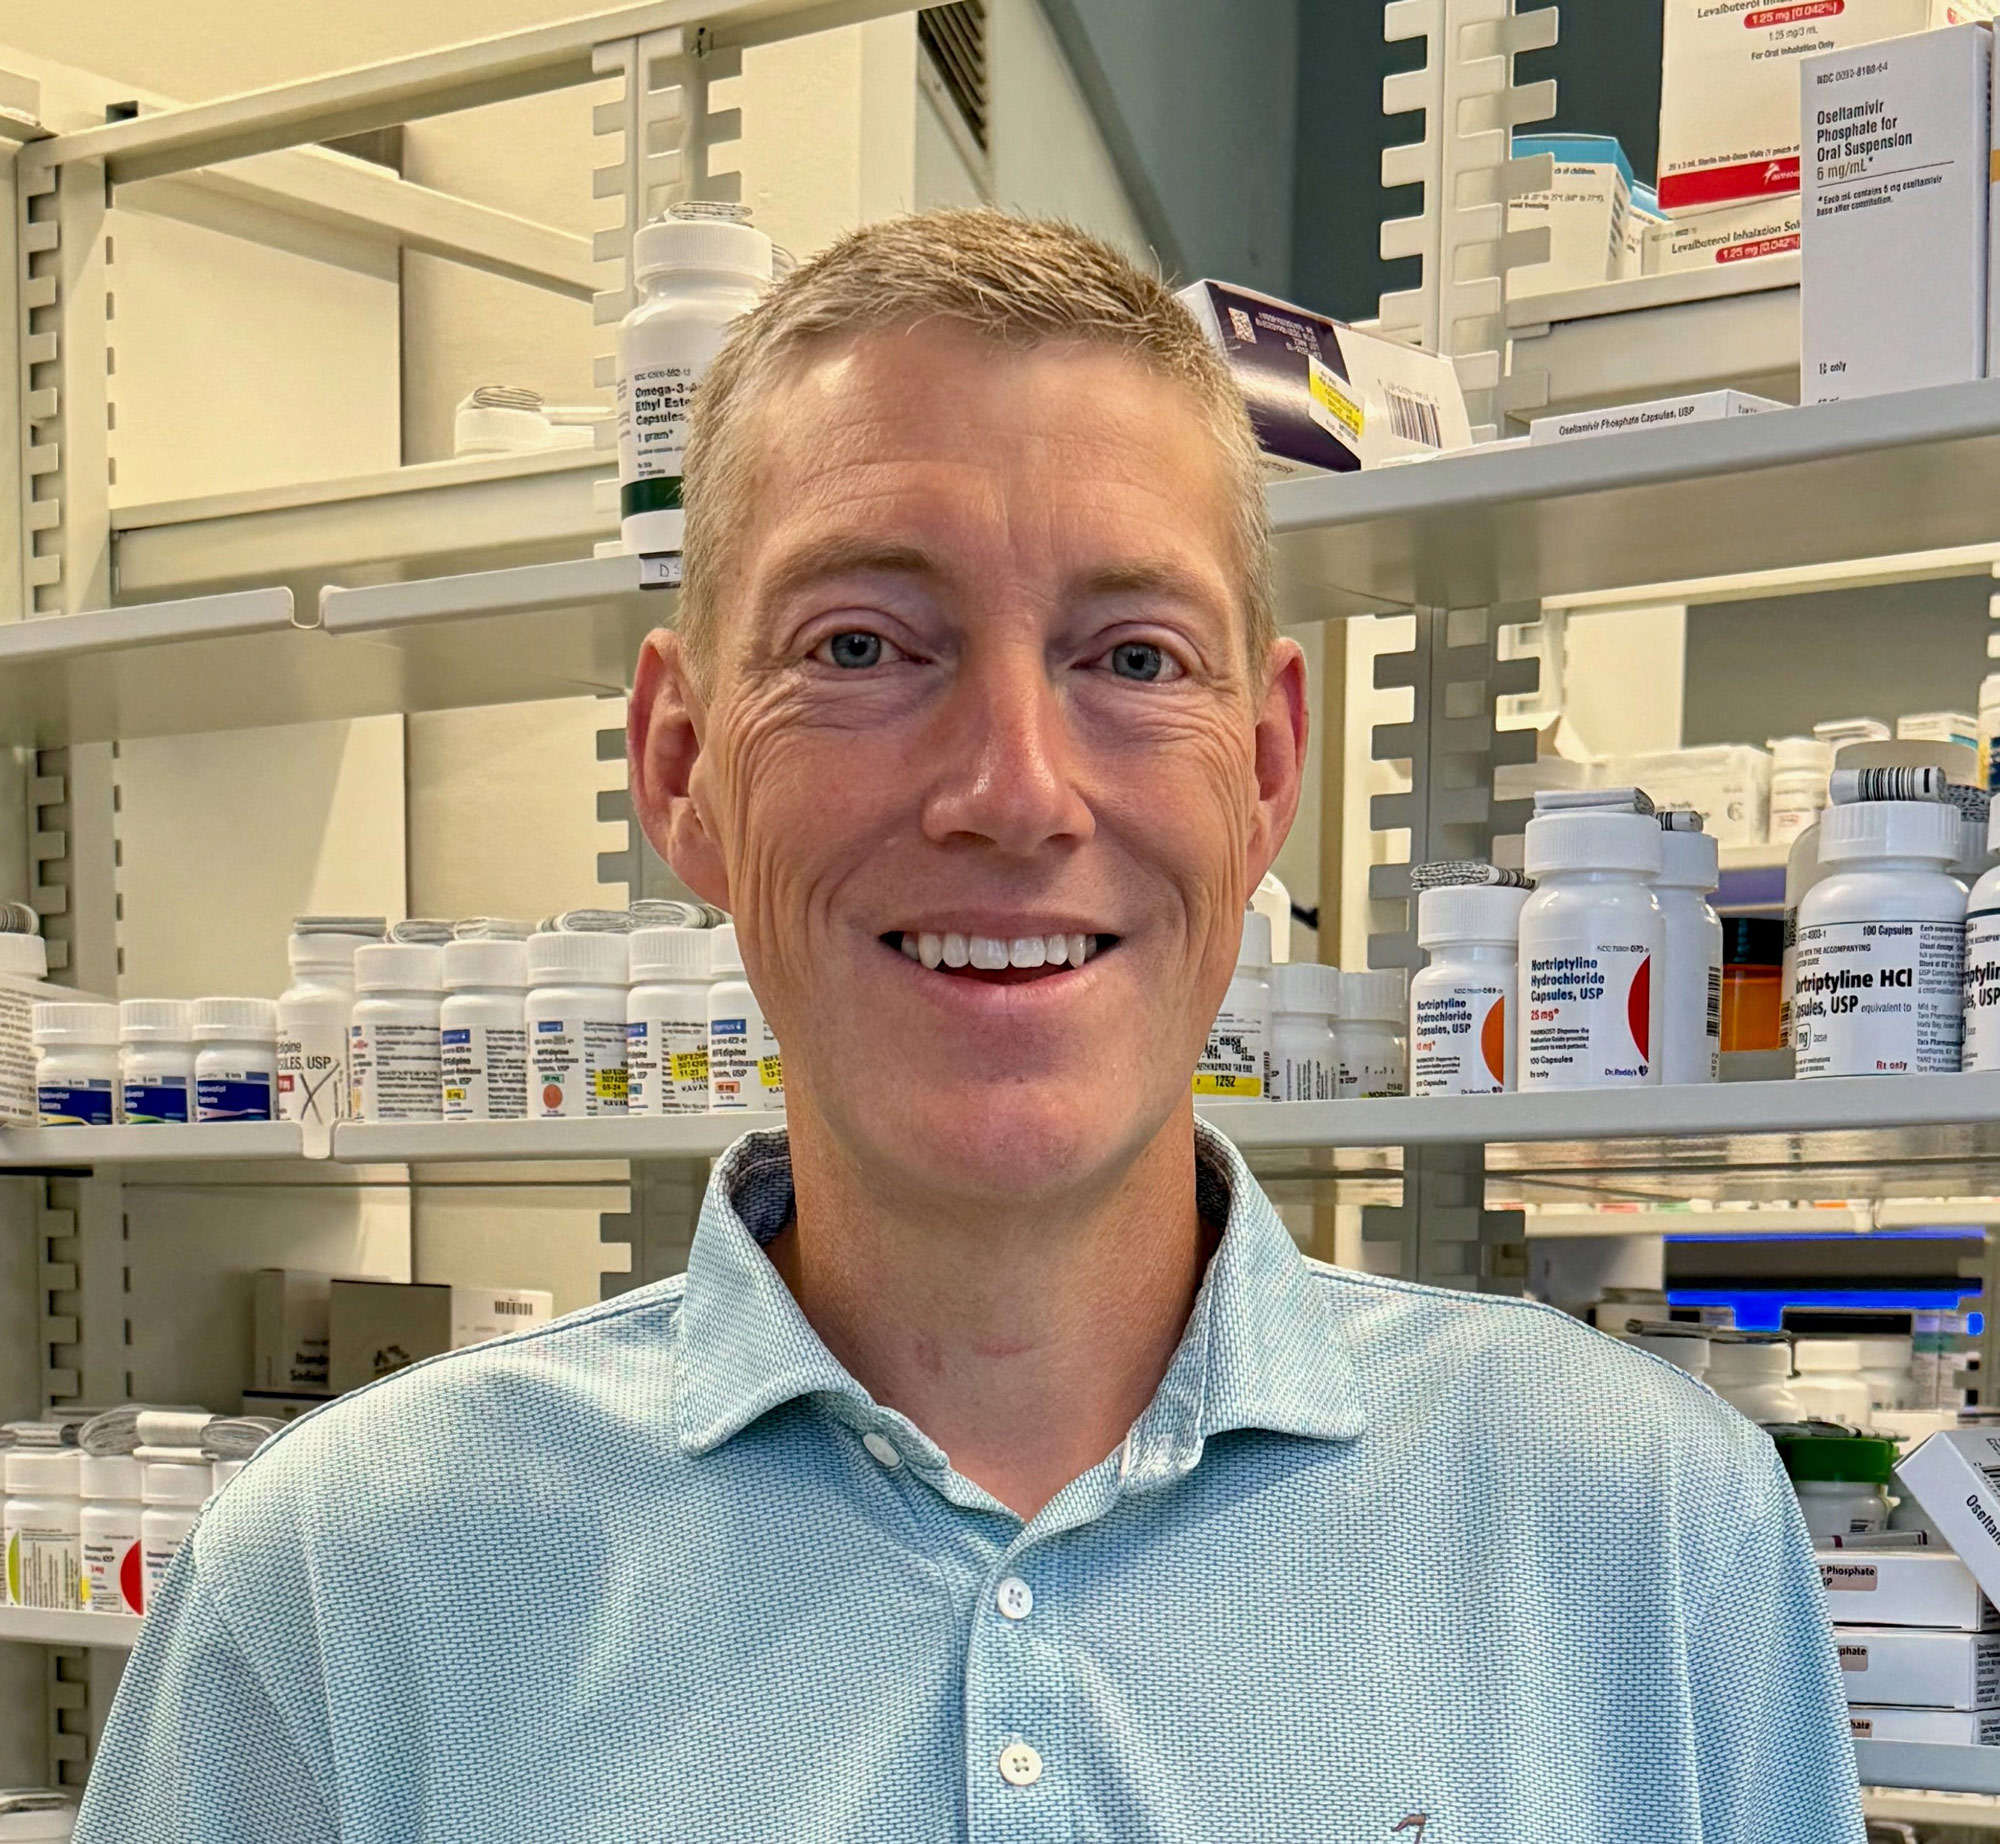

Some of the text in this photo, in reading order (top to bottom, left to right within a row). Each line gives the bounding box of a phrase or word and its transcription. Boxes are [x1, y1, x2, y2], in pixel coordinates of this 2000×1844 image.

[1752, 13, 1773, 25] 1.25
[1775, 11, 1790, 22] mg
[1751, 40, 1835, 61] For Oral Inhalation Only
[1817, 99, 1885, 125] Oseltamivir
[1817, 116, 1898, 144] Phosphate for
[1817, 132, 1913, 162] Oral Suspension
[1817, 166, 1824, 180] 6
[1853, 188, 1882, 199] contains
[1816, 206, 1833, 217] base
[1834, 203, 1850, 214] after
[1671, 232, 1731, 254] Levalbuterol
[1733, 225, 1781, 242] Inhalation
[1722, 247, 1743, 260] 1.25
[1744, 246, 1759, 257] mg
[1830, 361, 1847, 373] only
[635, 399, 660, 412] Ethyl
[1559, 405, 1695, 436] Oseltamivir Phosphate Capsules, USP
[1863, 924, 1913, 937] 100 Capsules
[1920, 924, 1934, 932] Each
[1823, 943, 1871, 955] ACCOMPANYING
[1531, 957, 1598, 971] Nortriptyline
[1531, 972, 1605, 988] Hydrochloride
[1880, 968, 1913, 988] HCl
[1531, 988, 1604, 1004] Capsules, USP
[1417, 998, 1467, 1011] Nortriptyline
[1831, 996, 1858, 1014] USP
[1861, 1002, 1902, 1015] equivalent
[1903, 1001, 1912, 1013] to
[1417, 1011, 1472, 1025] Hydrochloride
[1416, 1023, 1471, 1036] Capsules, USP
[1566, 1035, 1590, 1043] provided
[307, 1055, 331, 1070] USP
[1540, 1055, 1574, 1065] Capsules
[1876, 1060, 1908, 1071] Rx only
[1536, 1070, 1549, 1078] only
[1826, 1565, 1875, 1577] Phosphate
[1839, 1646, 1867, 1656] phate
[1850, 1719, 1870, 1730] hate
